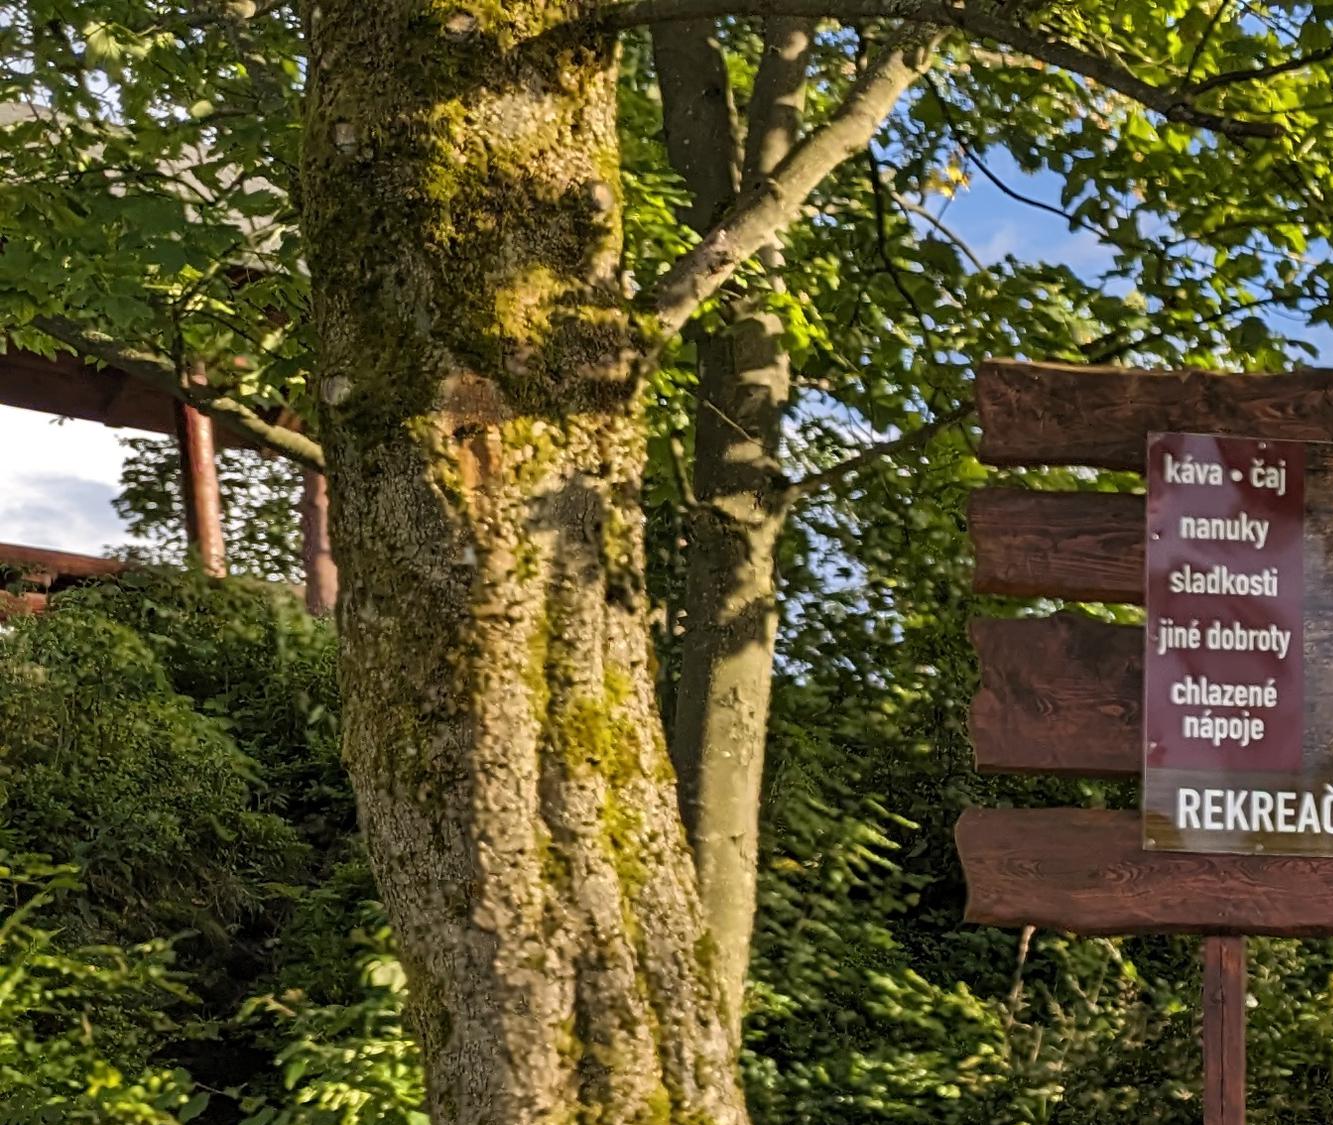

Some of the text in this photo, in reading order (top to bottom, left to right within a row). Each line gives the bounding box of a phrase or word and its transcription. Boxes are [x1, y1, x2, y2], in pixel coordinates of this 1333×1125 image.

[1164, 453, 1287, 496] káva čaj
[1180, 511, 1270, 550] nanuky
[1169, 564, 1278, 597] sladkosti
[1158, 618, 1291, 660] jiné dobroty
[1171, 675, 1278, 708] chlazené
[1184, 709, 1265, 747] nápoje
